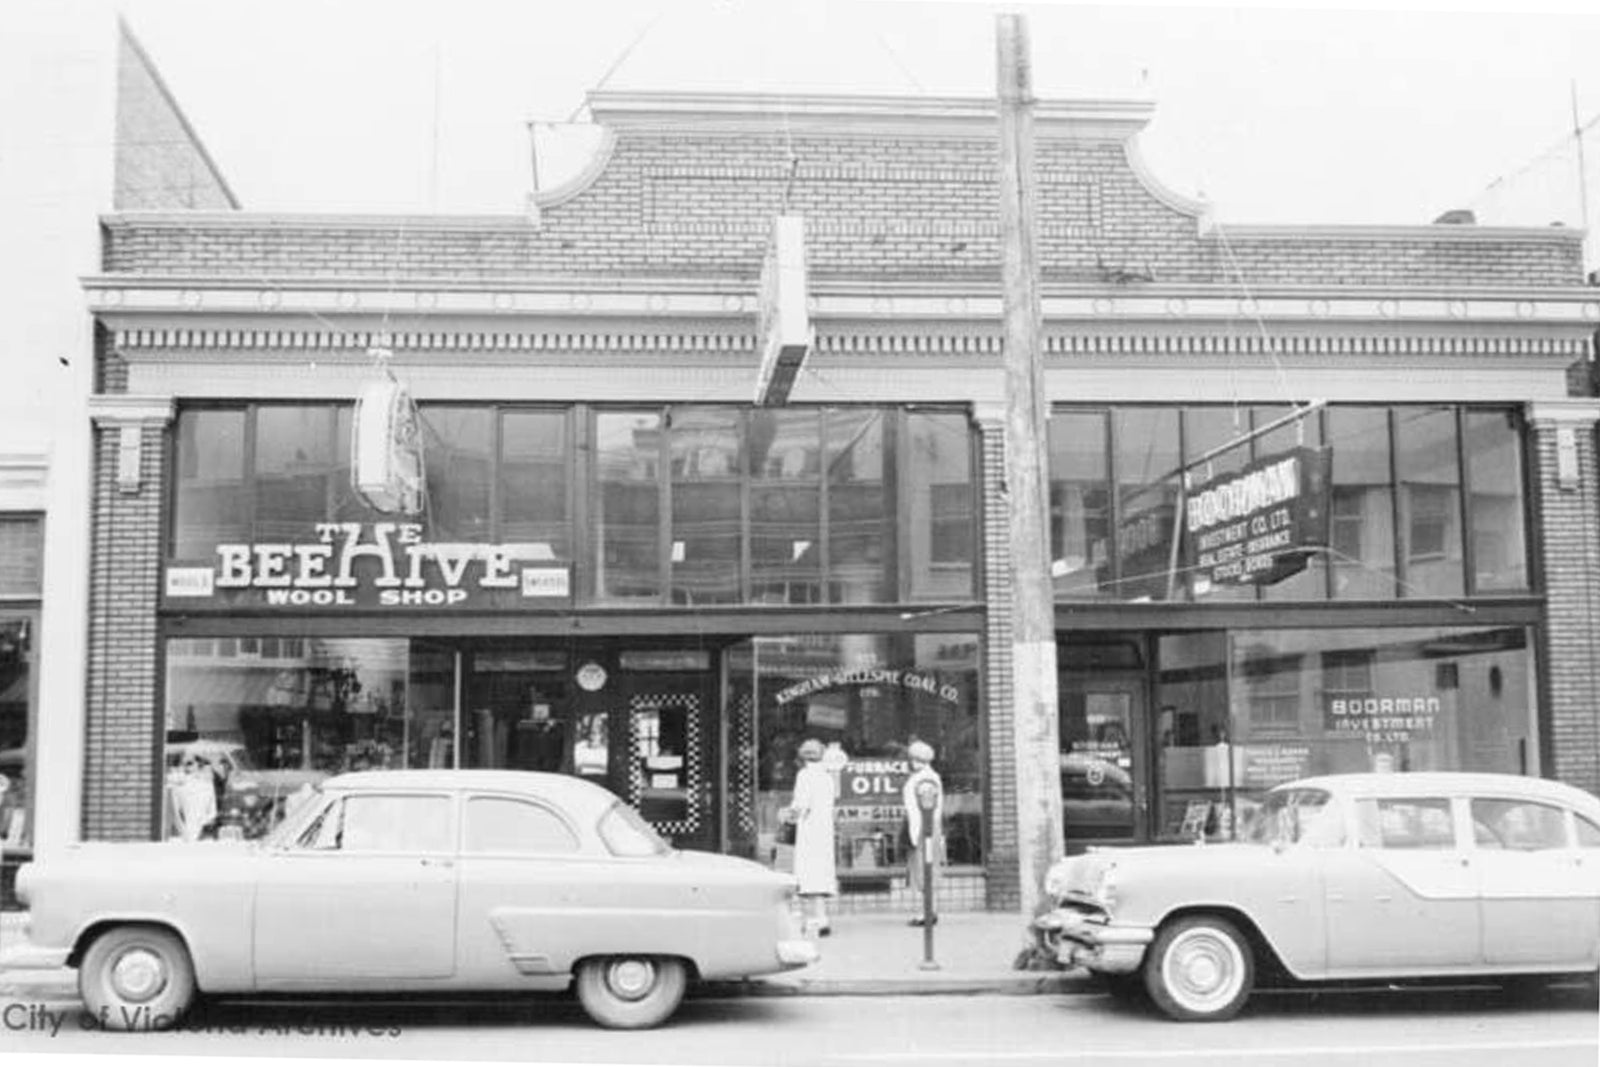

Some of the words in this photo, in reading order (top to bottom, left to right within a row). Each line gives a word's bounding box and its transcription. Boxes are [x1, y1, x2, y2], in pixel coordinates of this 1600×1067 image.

[266, 590, 356, 605] WOOL
[379, 590, 467, 605] SHOP
[904, 673, 937, 693] COAL
[1332, 698, 1440, 714] BOORMAN
[1335, 716, 1434, 730] INVESTMENT
[852, 777, 898, 794] OIL
